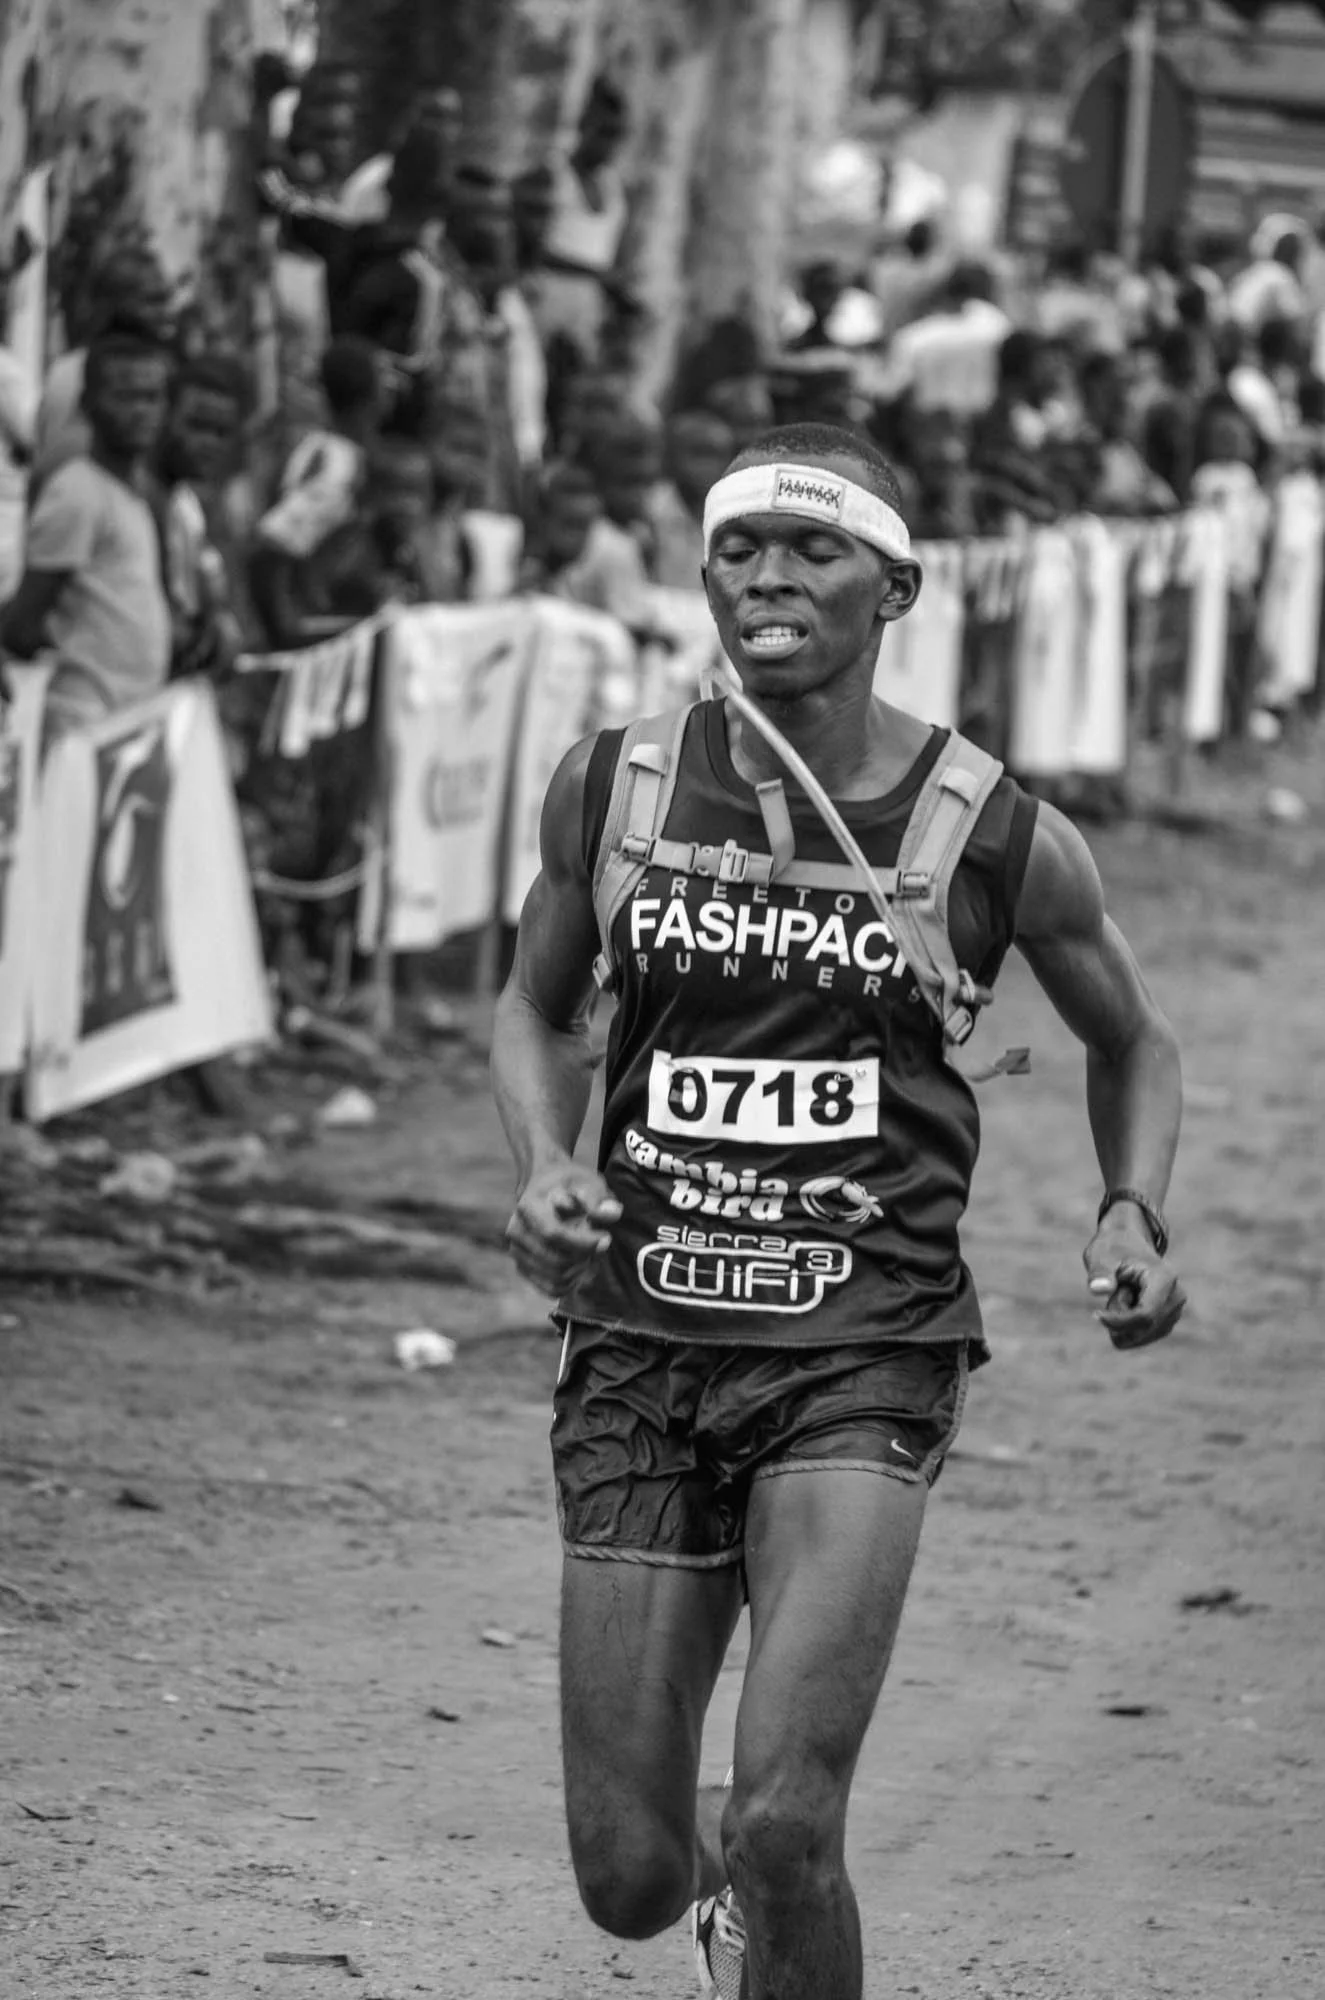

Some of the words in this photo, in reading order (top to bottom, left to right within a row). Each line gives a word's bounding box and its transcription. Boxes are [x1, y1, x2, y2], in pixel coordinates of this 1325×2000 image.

[778, 478, 841, 508] FASHPACK
[635, 876, 855, 914] FREETO
[668, 1067, 854, 1126] 0718
[670, 1179, 784, 1221] bird
[657, 1225, 786, 1251] sierra
